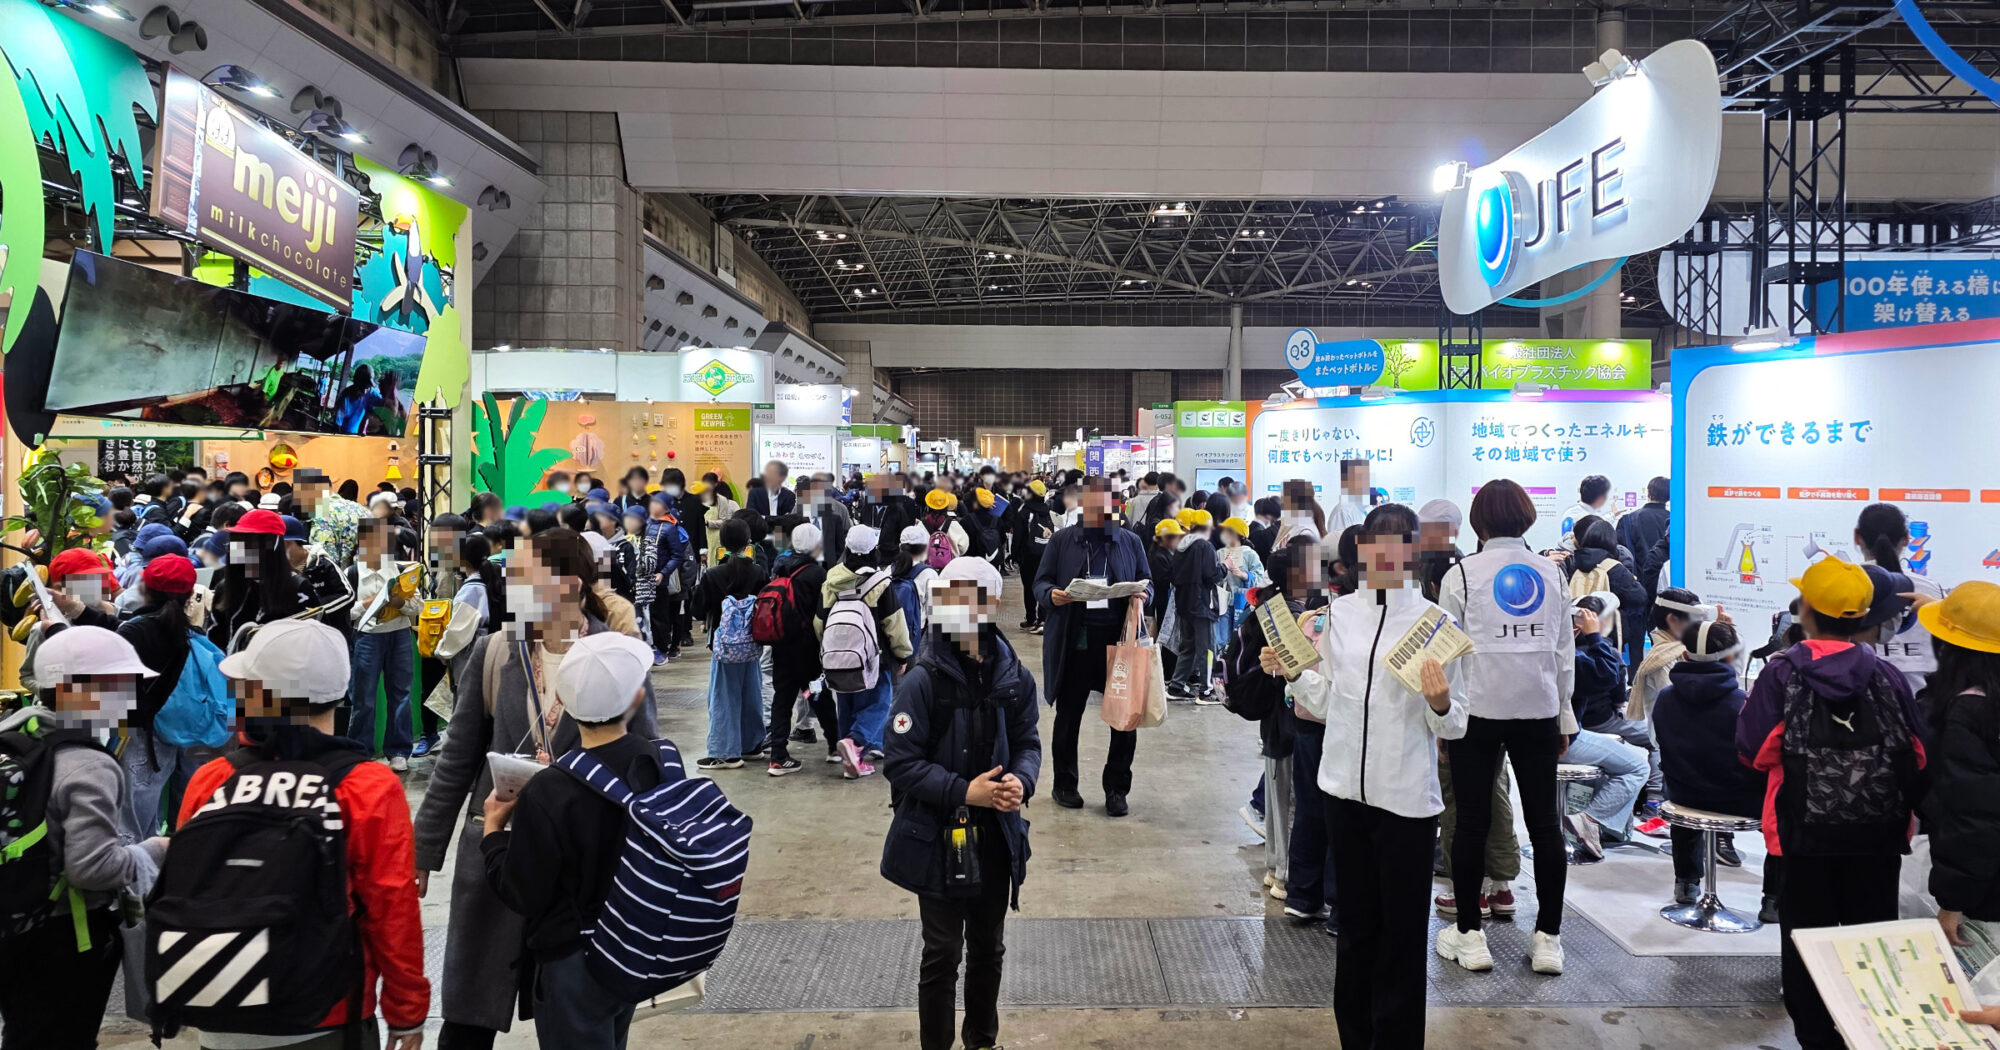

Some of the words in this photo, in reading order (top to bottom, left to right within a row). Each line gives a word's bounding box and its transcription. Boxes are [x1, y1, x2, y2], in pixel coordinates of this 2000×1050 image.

[233, 145, 338, 253] meiji
[1524, 136, 1627, 248] JFE
[1873, 302, 1971, 323] 架け替える
[1290, 339, 1310, 360] Q3
[1315, 363, 1378, 376] またペットボトルに
[1707, 419, 1873, 447] 鉄ができるまで
[1471, 445, 1588, 462] その地域で使う
[1495, 623, 1545, 639] JFE
[1874, 642, 1922, 656] FE
